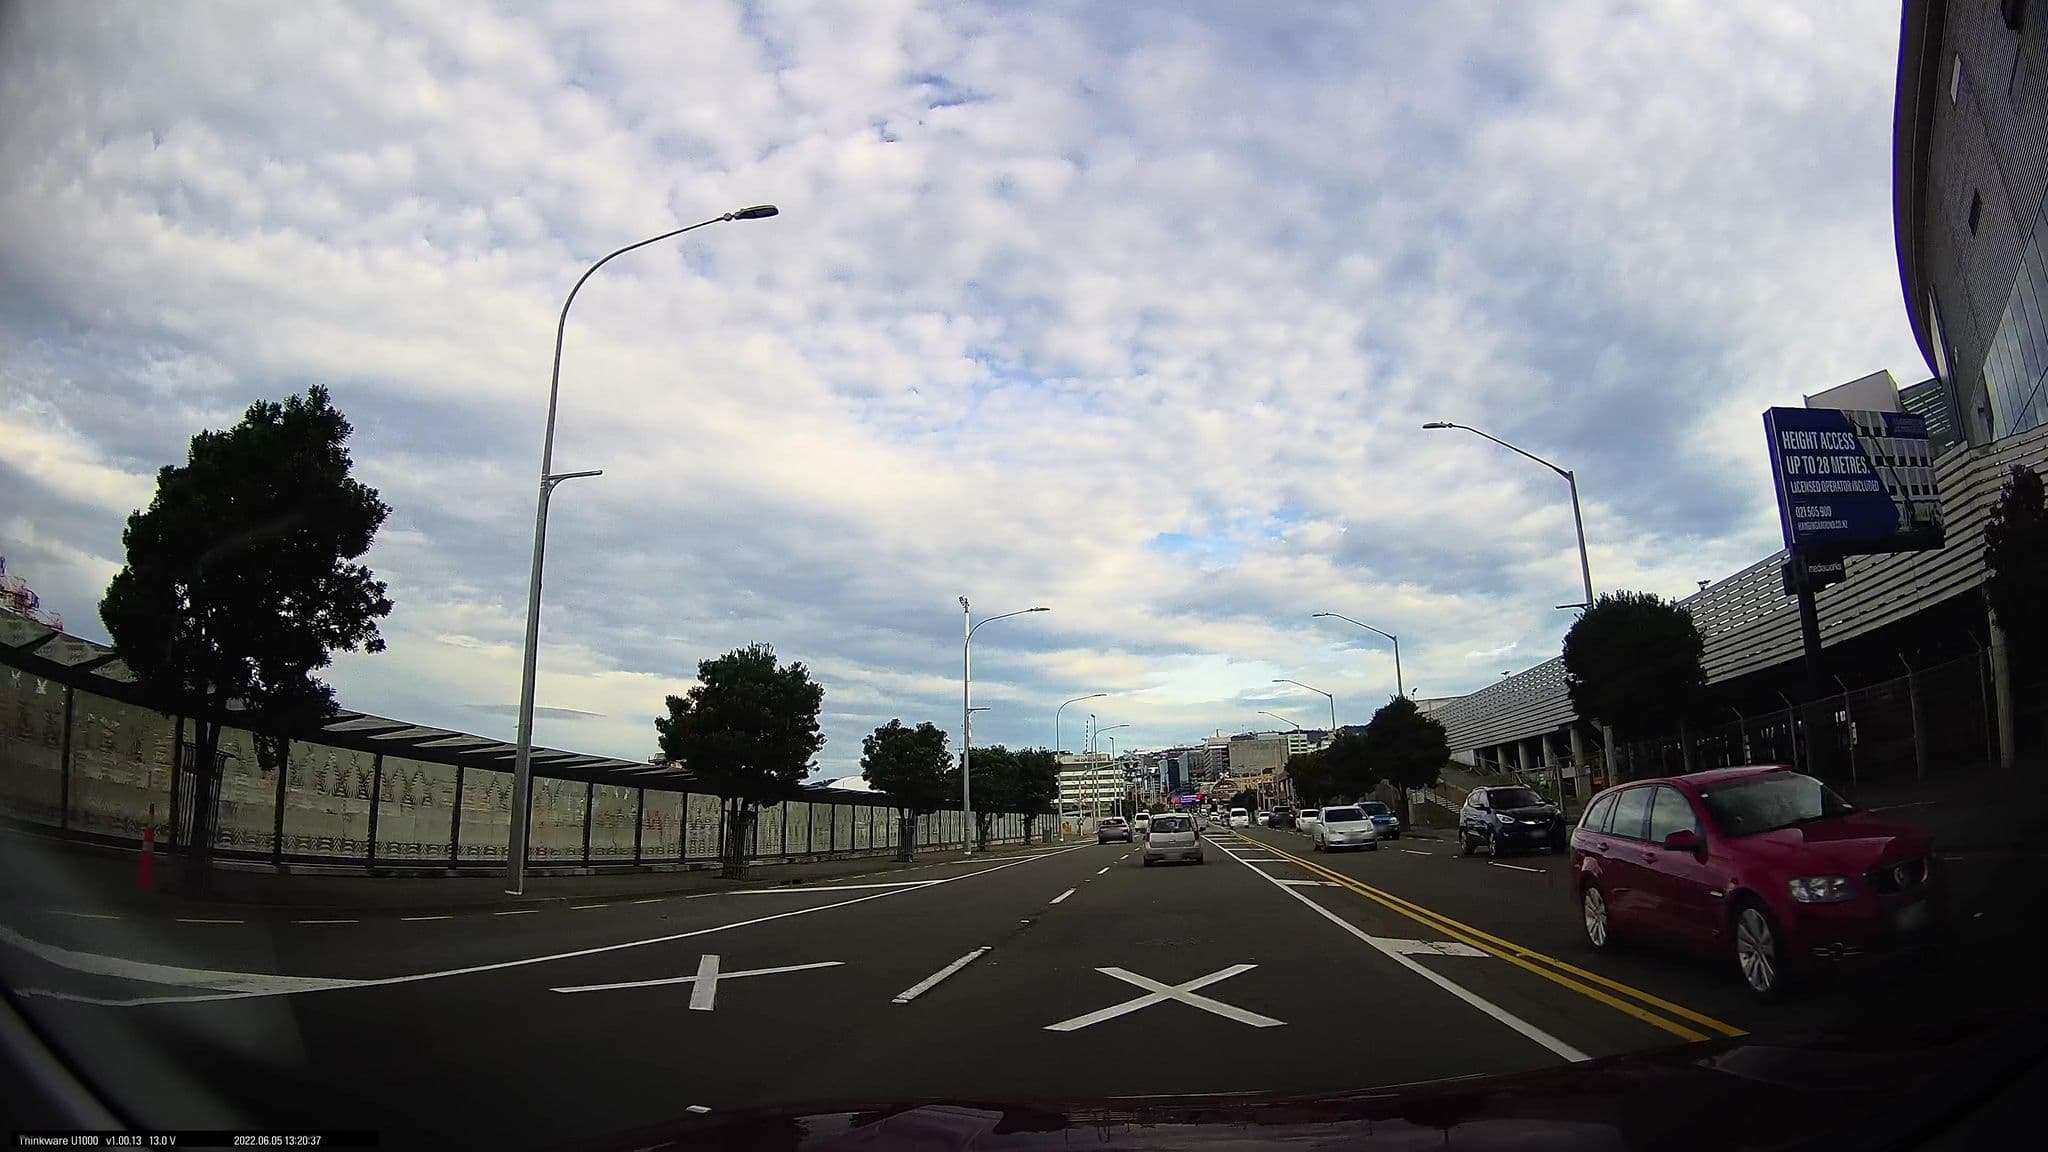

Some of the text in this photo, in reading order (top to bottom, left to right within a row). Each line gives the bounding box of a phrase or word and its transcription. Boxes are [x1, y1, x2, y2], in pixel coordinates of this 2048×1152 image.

[1781, 431, 1856, 450] HEIGHT ACCESS
[1786, 455, 1871, 475] UP TO 28 METRES.
[1790, 480, 1880, 494] LICENSED OPERATOR INCLUDED
[1795, 506, 1807, 518] 021
[1819, 505, 1832, 518] 900
